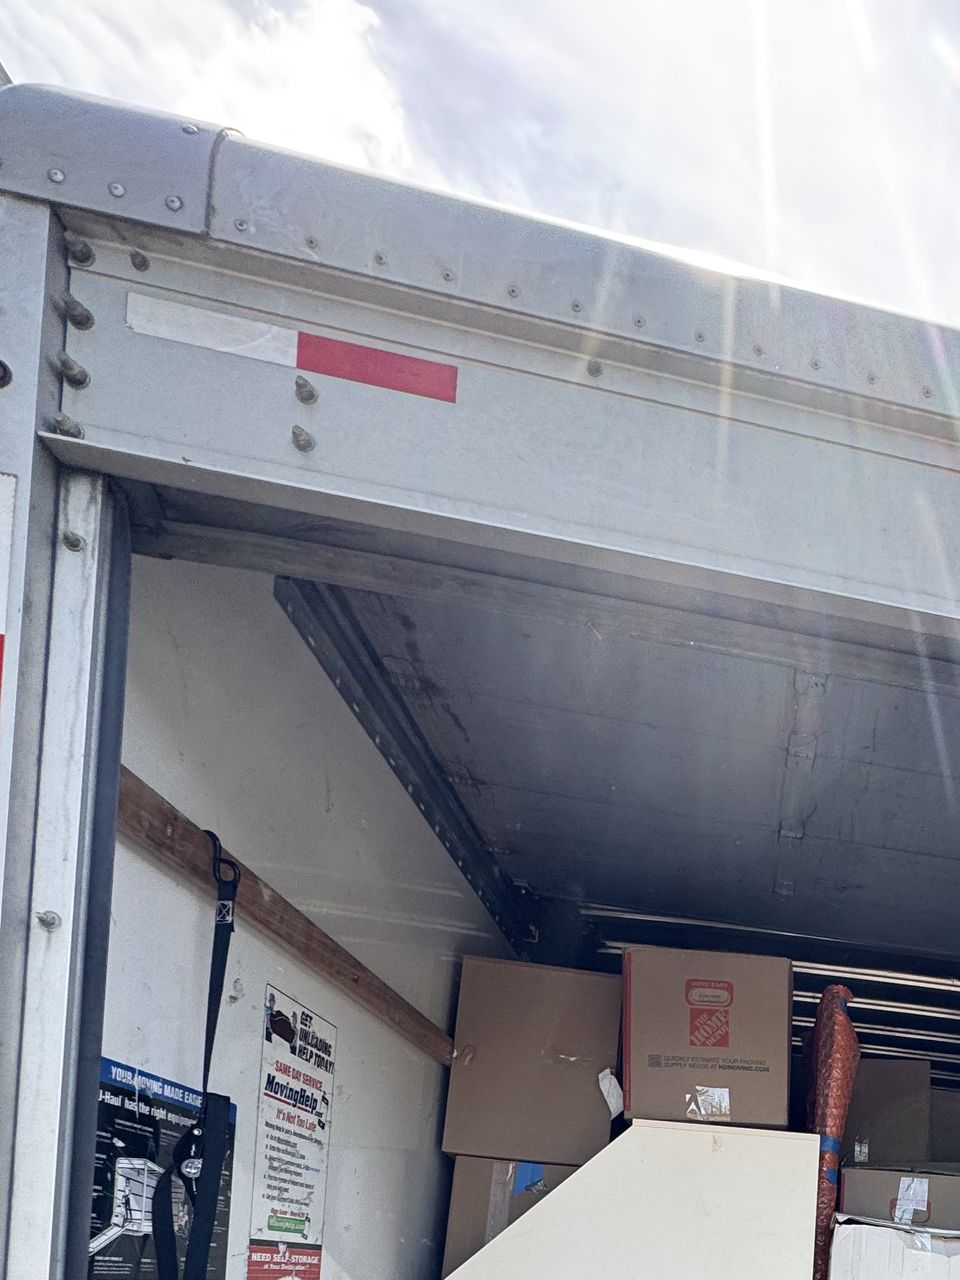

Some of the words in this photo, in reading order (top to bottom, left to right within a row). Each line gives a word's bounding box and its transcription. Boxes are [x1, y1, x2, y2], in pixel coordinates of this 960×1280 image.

[300, 1011, 314, 1028] GET
[690, 1008, 729, 1046] HOME
[696, 1012, 710, 1028] THE
[298, 1027, 332, 1058] UNLOADING
[706, 1024, 729, 1047] DEPOT
[298, 1044, 314, 1063] HELP
[314, 1053, 335, 1075] TODAY!
[718, 1064, 770, 1072] HDMOVING.COM
[112, 1066, 133, 1085] YOUR
[134, 1074, 162, 1094] MOVING
[164, 1084, 184, 1102] MADE
[184, 1093, 202, 1108] EASIE
[275, 1060, 292, 1077] SAME
[292, 1068, 302, 1080] DAY
[302, 1072, 324, 1092] SERVICE
[264, 1073, 318, 1114] MovingHelp
[124, 1098, 138, 1110] has
[138, 1100, 150, 1114] the
[150, 1104, 166, 1120] right
[276, 1107, 286, 1120] It's
[286, 1112, 296, 1126] Not
[296, 1116, 304, 1128] Too
[305, 1118, 316, 1132] Late
[252, 1252, 272, 1262] NEED
